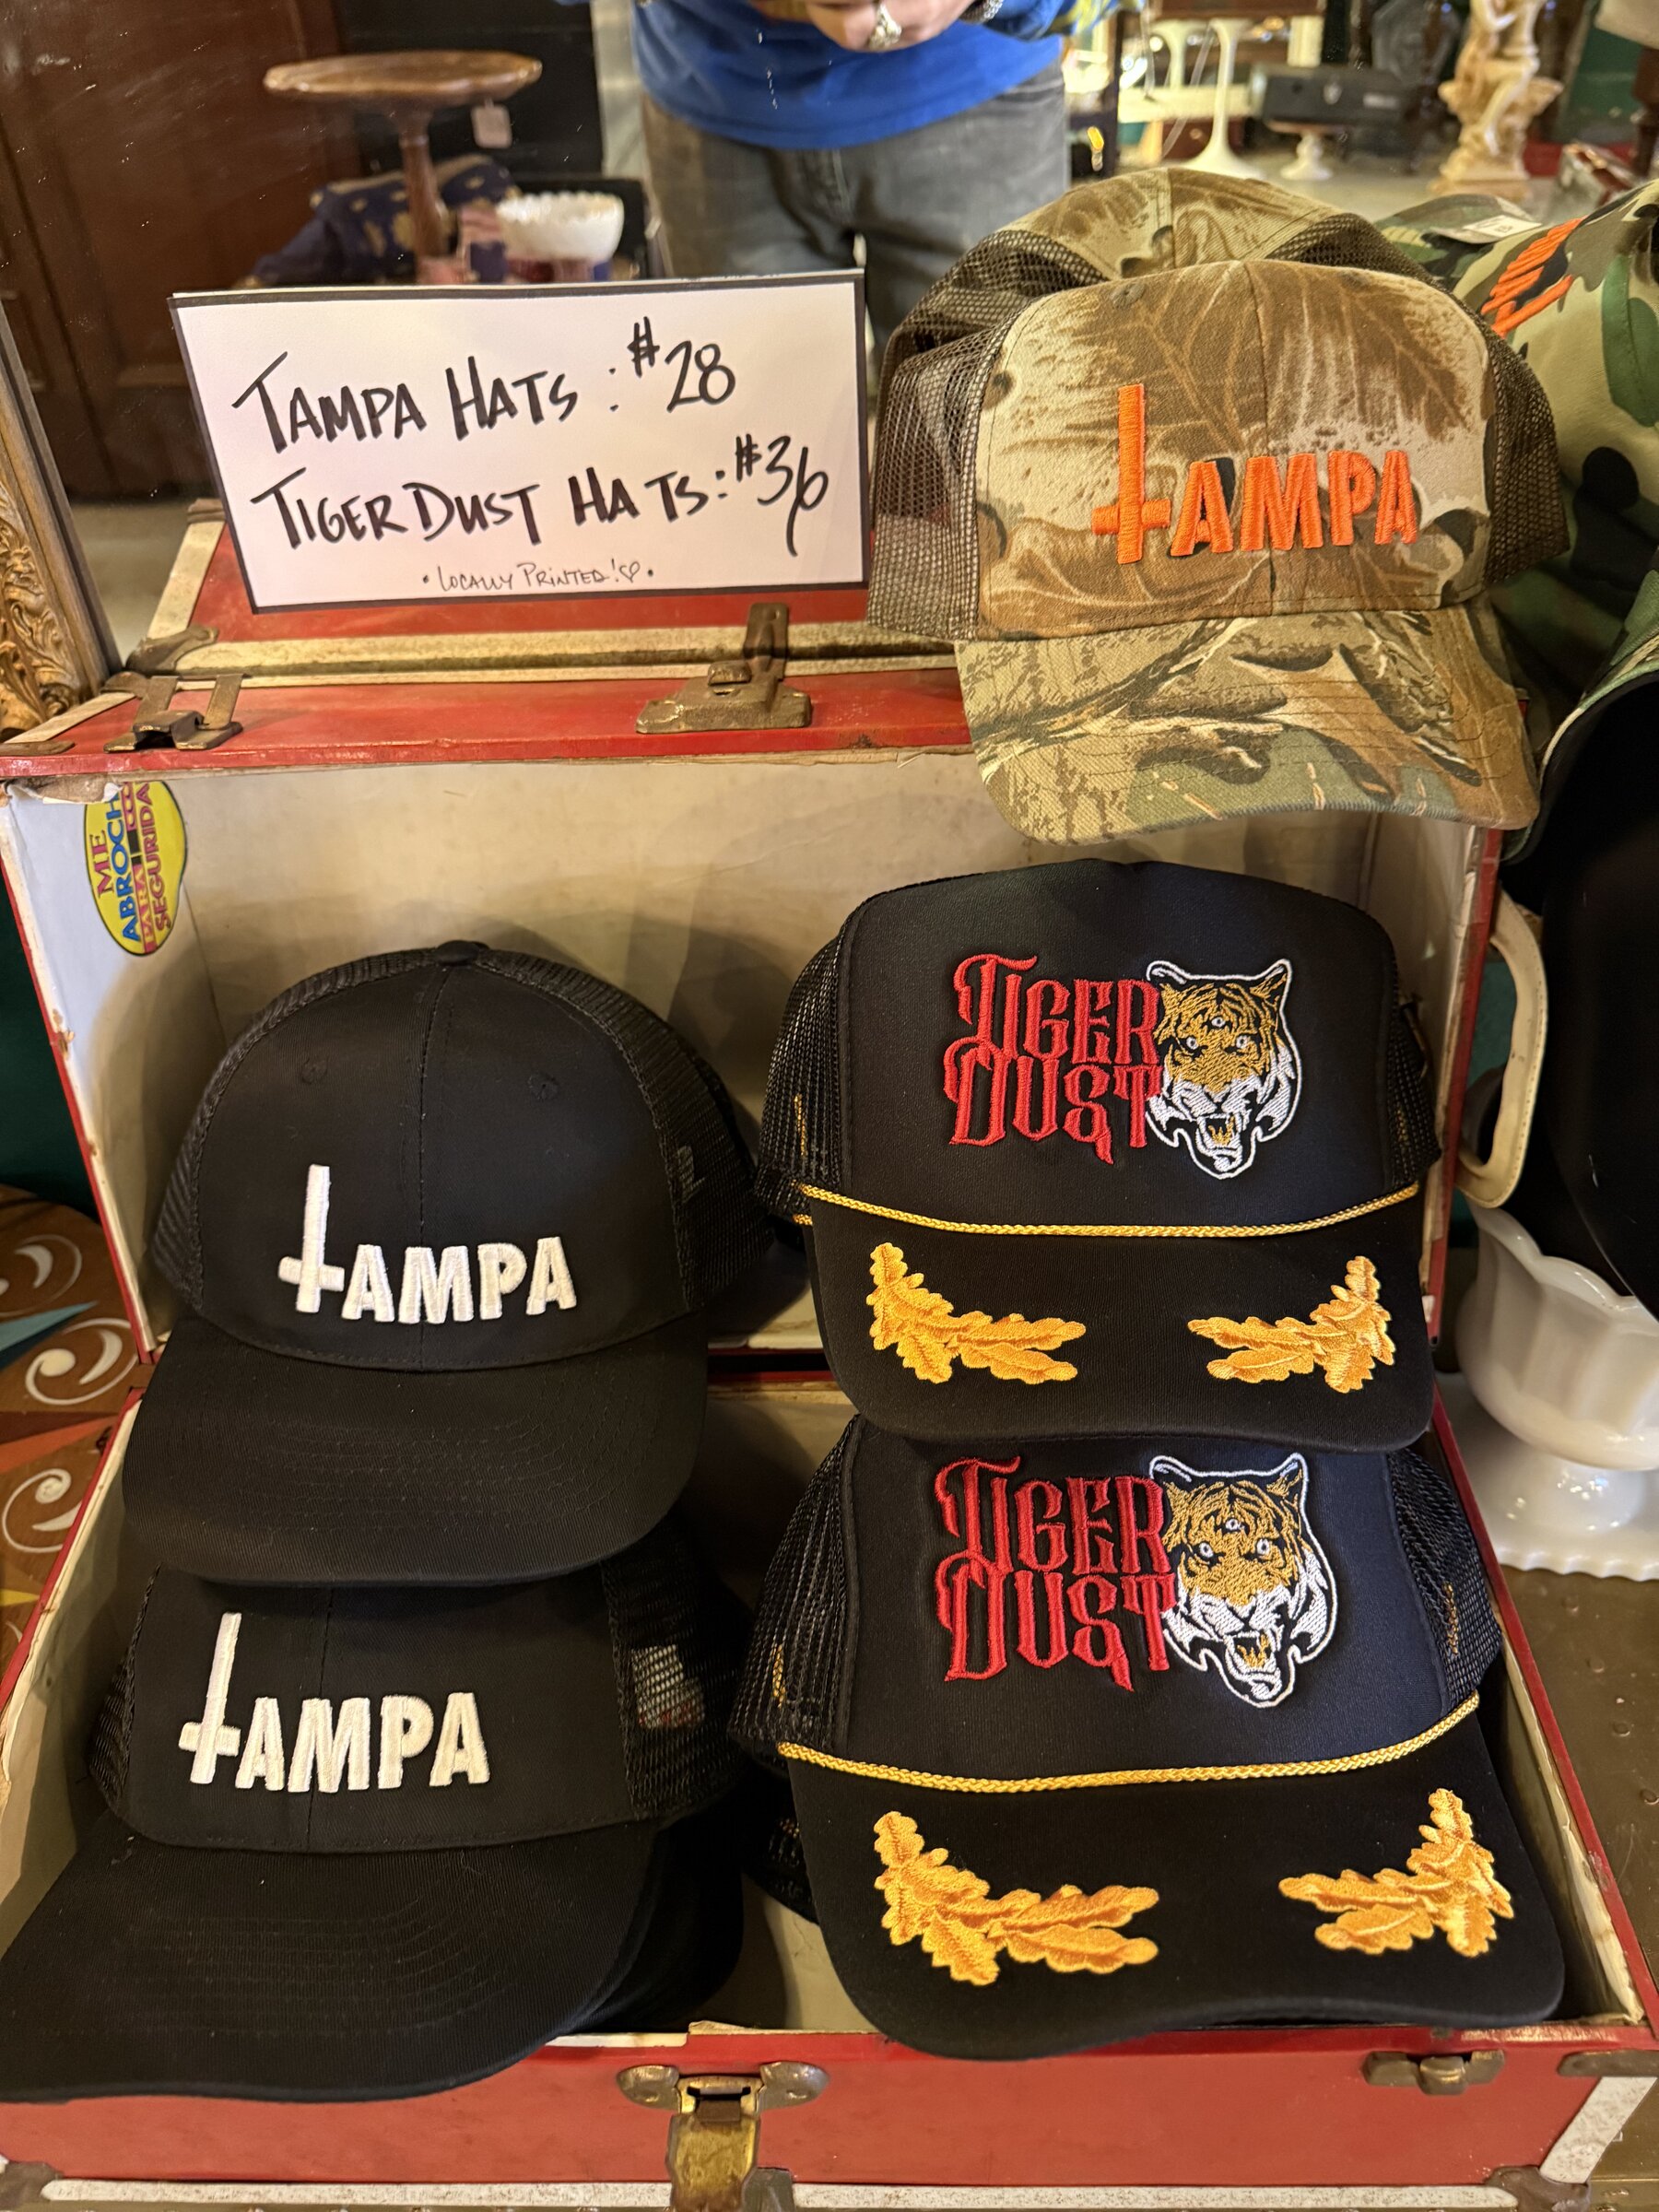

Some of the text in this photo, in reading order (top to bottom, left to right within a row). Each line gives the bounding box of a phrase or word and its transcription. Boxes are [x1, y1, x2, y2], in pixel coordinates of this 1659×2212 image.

[89, 830, 114, 898] ME
[106, 789, 141, 942] ABROCH
[136, 782, 171, 931] SEGURIDA
[953, 953, 1161, 1066] TIGER
[942, 1037, 1163, 1164] DUST
[935, 1455, 1171, 1575] TIGER
[935, 1551, 1176, 1691] DUST
